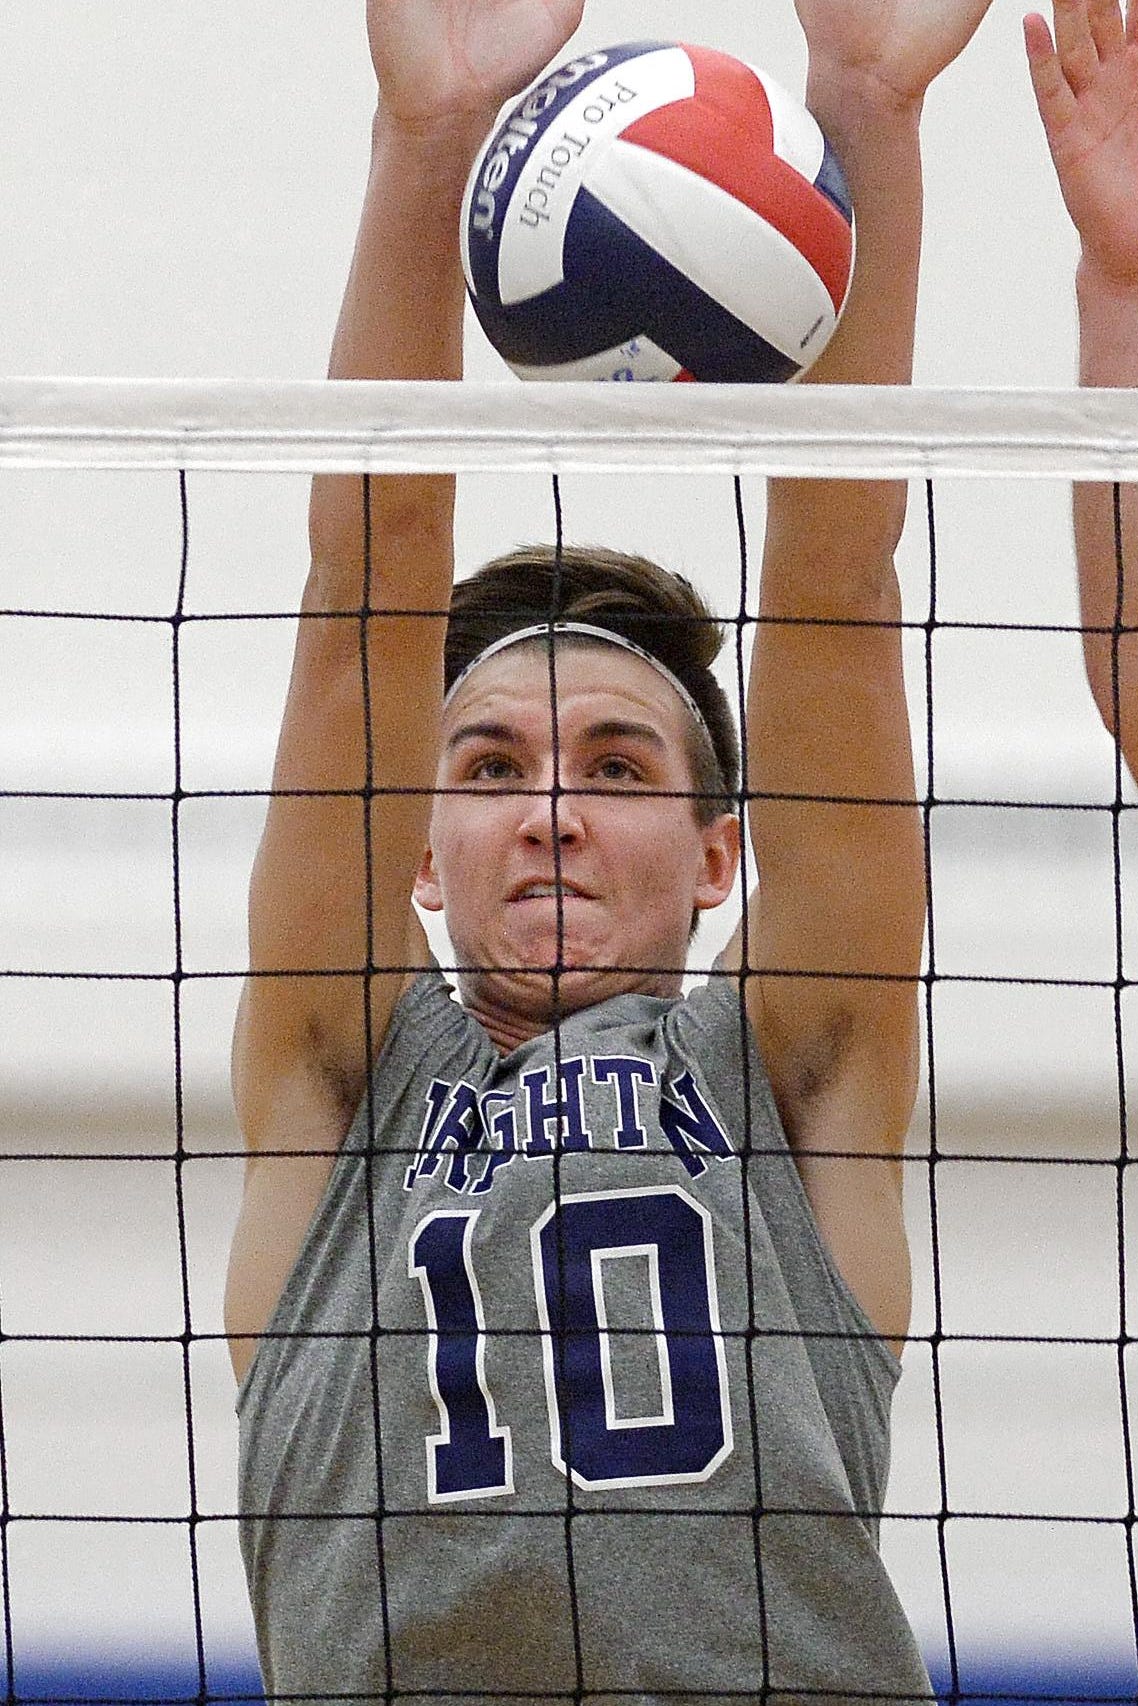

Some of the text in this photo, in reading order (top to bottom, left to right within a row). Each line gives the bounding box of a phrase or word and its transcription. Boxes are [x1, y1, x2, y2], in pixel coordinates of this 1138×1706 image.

[519, 81, 638, 228] Pro Touch
[408, 1185, 734, 1504] 10
